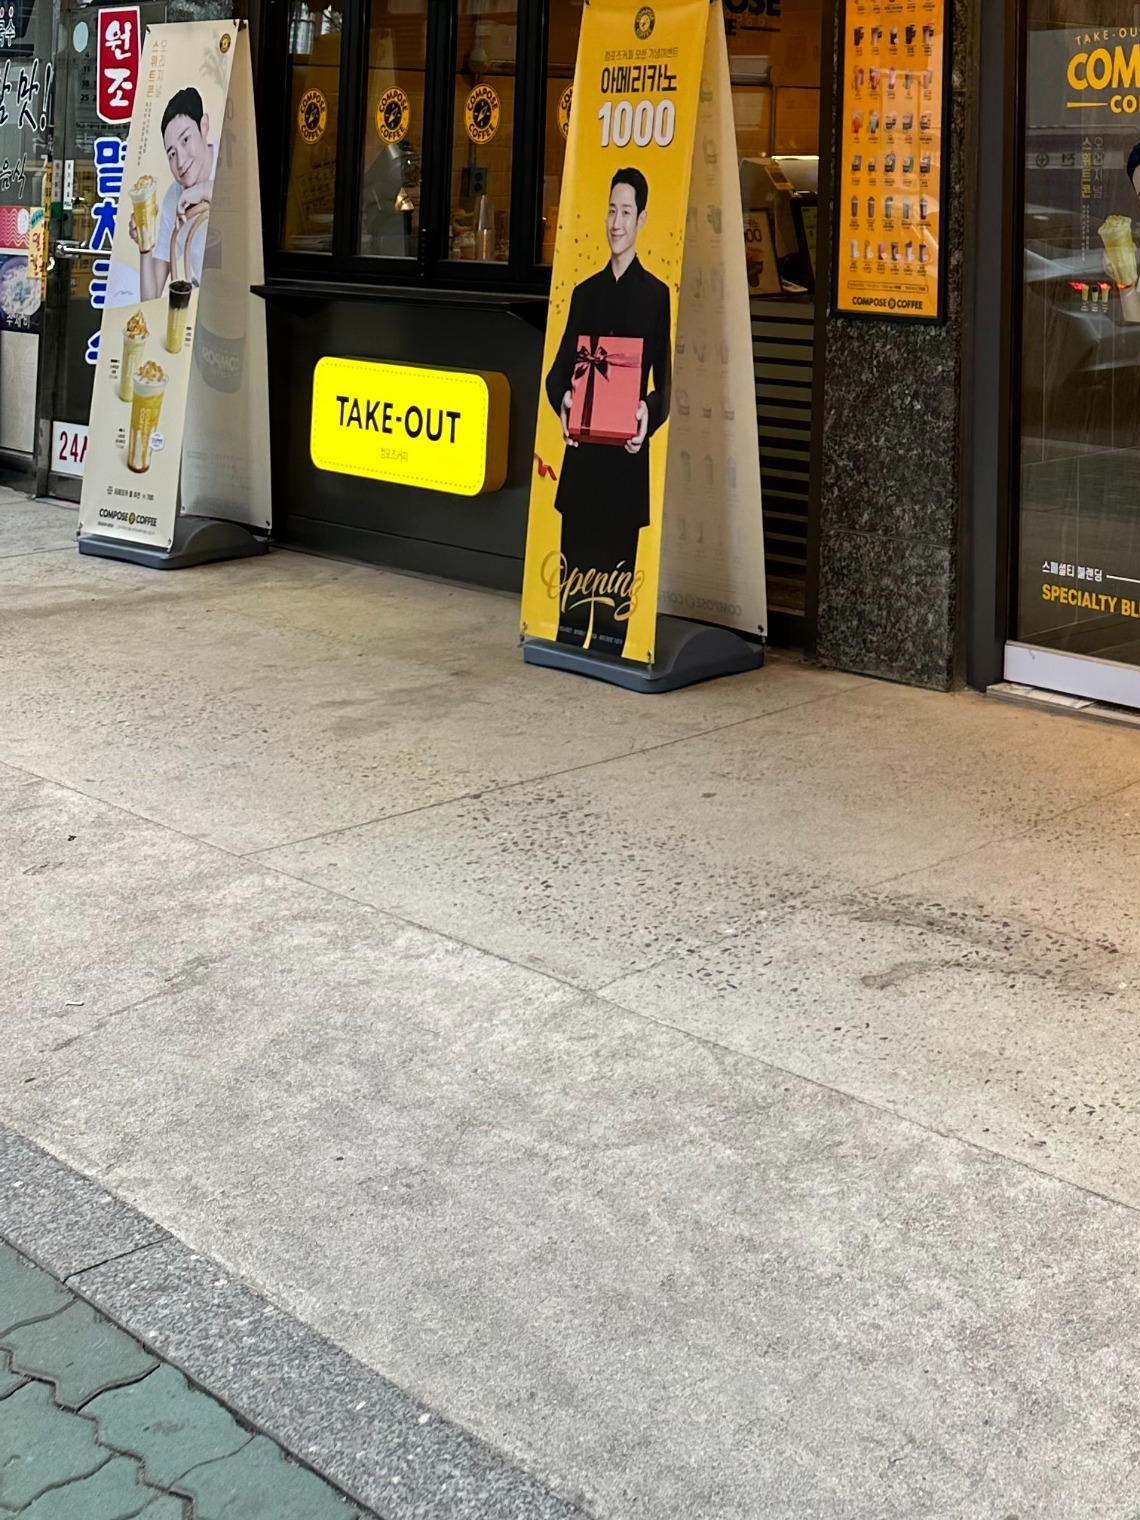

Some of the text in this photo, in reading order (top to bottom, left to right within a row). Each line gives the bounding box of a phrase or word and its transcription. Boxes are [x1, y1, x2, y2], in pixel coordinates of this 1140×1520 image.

[104, 20, 132, 108] 원조
[601, 64, 677, 94] 아메리카노
[301, 90, 326, 114] COMPOSE
[379, 90, 409, 113] COMPOSE
[467, 87, 498, 111] COMPOSE
[380, 124, 405, 141] COFFEE
[468, 124, 495, 140] COFFEE
[597, 98, 675, 148] 1000
[852, 296, 923, 309] COMPOSE COFFEE
[6, 313, 31, 329] 수제비
[336, 395, 461, 444] TAKE-OUT
[99, 508, 157, 527] COMPOSE COFFEE
[540, 550, 645, 625] Opening
[1041, 583, 1117, 613] SPECIALTY
